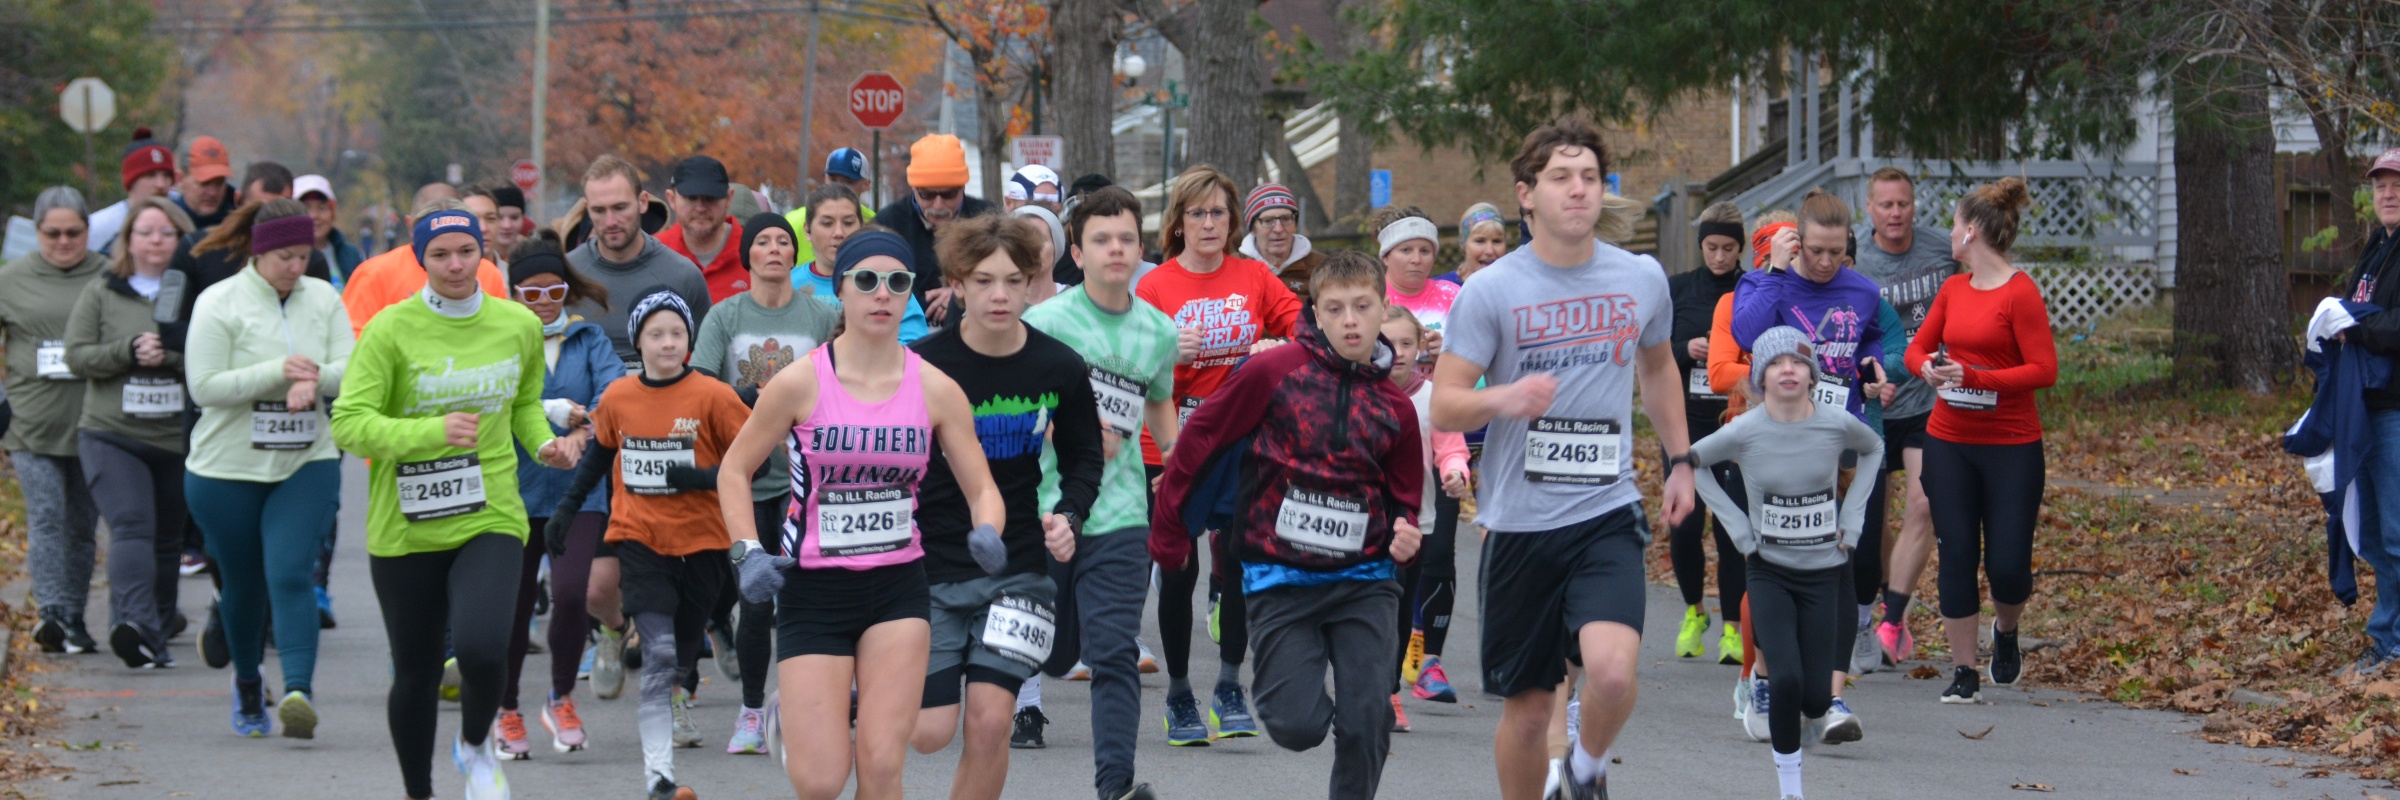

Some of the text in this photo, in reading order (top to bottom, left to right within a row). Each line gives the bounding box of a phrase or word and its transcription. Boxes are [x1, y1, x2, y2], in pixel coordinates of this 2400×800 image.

[853, 88, 902, 112] STOP
[1180, 298, 1225, 322] RIVER
[1229, 299, 1242, 308] TO
[1203, 310, 1251, 328] RIVER
[1512, 293, 1638, 344] LIONS
[1200, 324, 1257, 350] RELAY
[1573, 351, 1608, 366] FIELD
[1091, 367, 1103, 380] So
[1118, 378, 1141, 394] Racing
[137, 392, 169, 404] 2421
[1186, 398, 1198, 407] So
[1817, 388, 1834, 405] 15
[268, 419, 304, 433] 2441
[1537, 419, 1552, 430] So
[1574, 421, 1610, 434] Racing
[626, 439, 635, 449] So
[651, 440, 682, 450] Racing
[812, 423, 927, 455] SOUTHERN
[1529, 437, 1544, 448] So
[623, 454, 632, 463] So
[1547, 442, 1599, 463] 2463
[402, 465, 416, 474] So
[434, 458, 469, 471] Racing
[399, 482, 413, 492] So
[416, 478, 464, 501] 2487
[828, 491, 843, 503] So
[866, 488, 902, 501] Racing
[1292, 488, 1306, 500] So
[1326, 496, 1361, 512] Racing
[1772, 495, 1784, 505] So
[1801, 493, 1828, 505] Racing
[821, 511, 837, 522] So
[1282, 505, 1296, 516] So
[1765, 509, 1778, 518] So
[841, 511, 894, 534] 2426
[1297, 512, 1349, 538] 2490
[1780, 511, 1823, 529] 2518
[1002, 595, 1017, 609] So
[991, 612, 1006, 623] So
[1007, 618, 1047, 648] 2495
